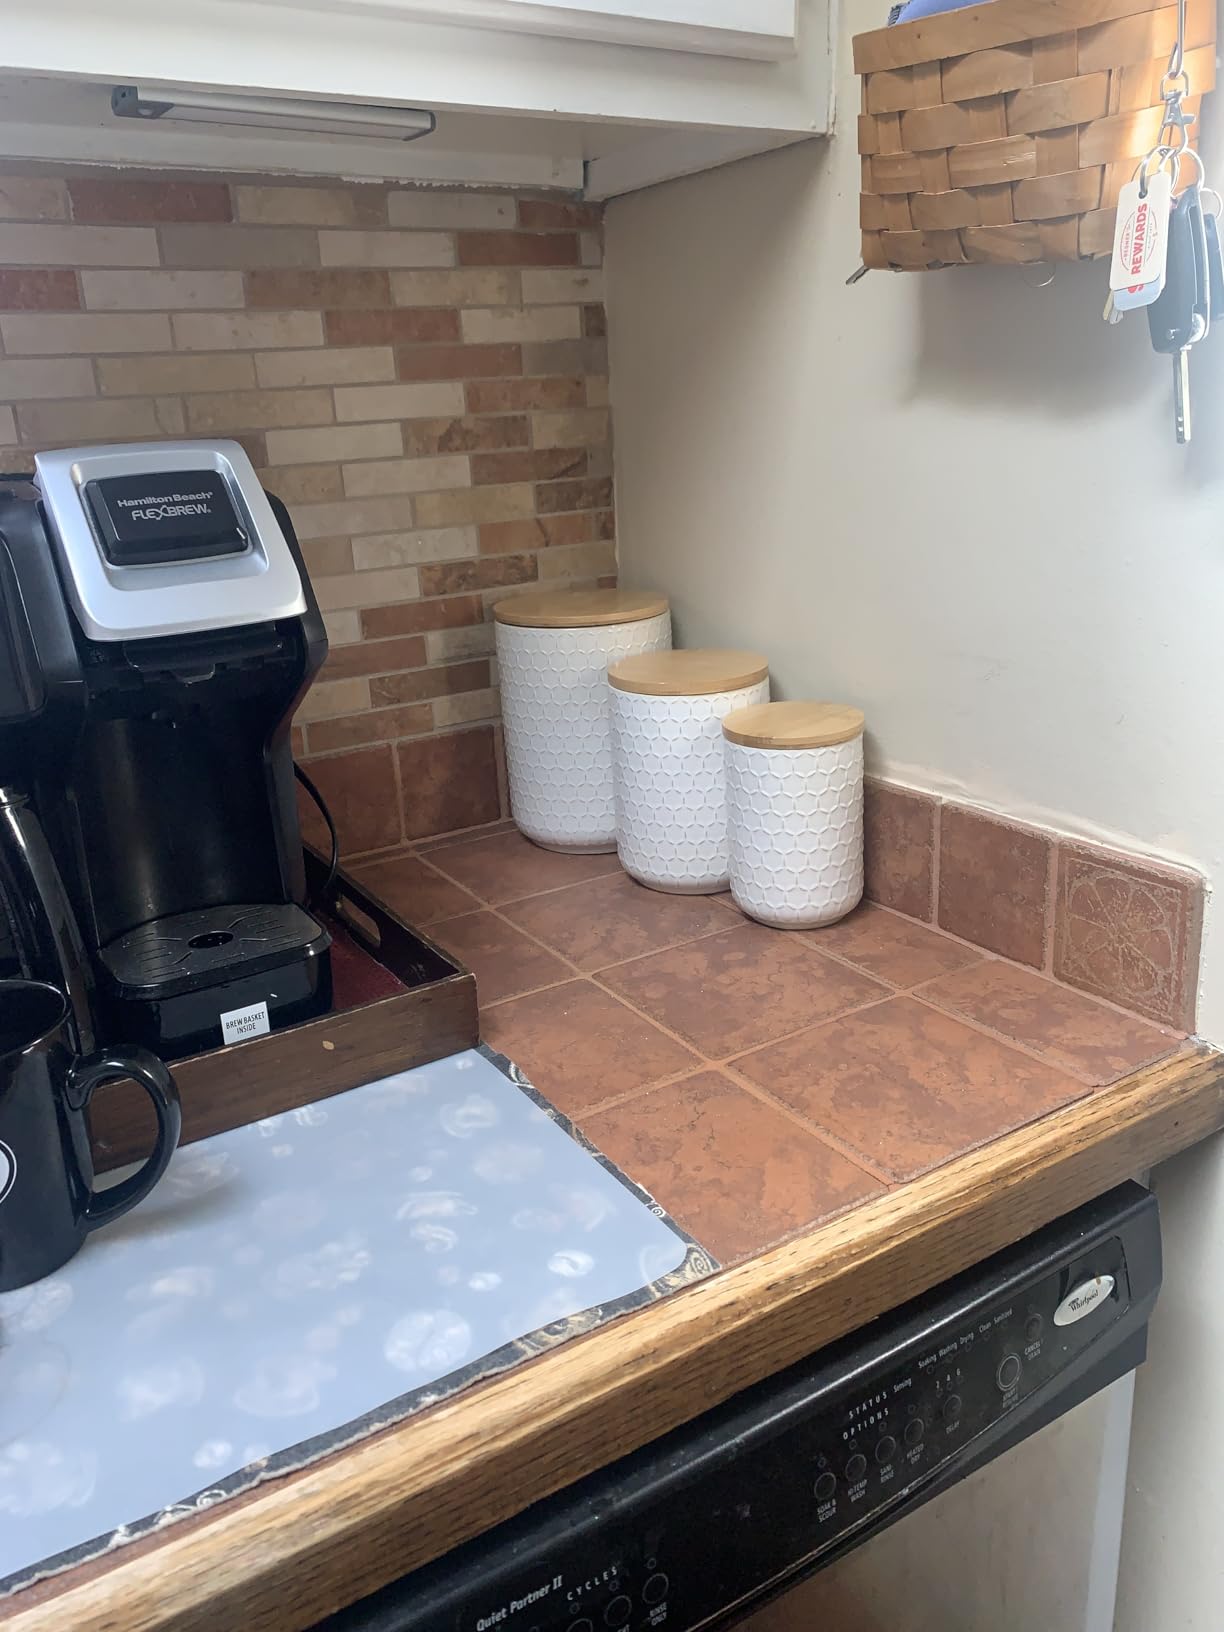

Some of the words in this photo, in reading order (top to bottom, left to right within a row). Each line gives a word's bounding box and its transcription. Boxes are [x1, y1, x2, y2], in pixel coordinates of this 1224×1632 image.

[1131, 203, 1148, 275] REWARDS
[117, 495, 173, 507] Hamilton
[226, 1018, 243, 1030] BREW
[243, 1011, 265, 1024] BASKET
[236, 1022, 256, 1034] INSIDE
[1069, 1290, 1099, 1312] Whirlpool
[849, 1391, 887, 1419] STATUS
[843, 1407, 889, 1440] OPTIONS
[566, 1566, 617, 1601] CYCLES
[476, 1607, 507, 1632] Quiet
[510, 1584, 551, 1614] Partner
[552, 1574, 563, 1591] II
